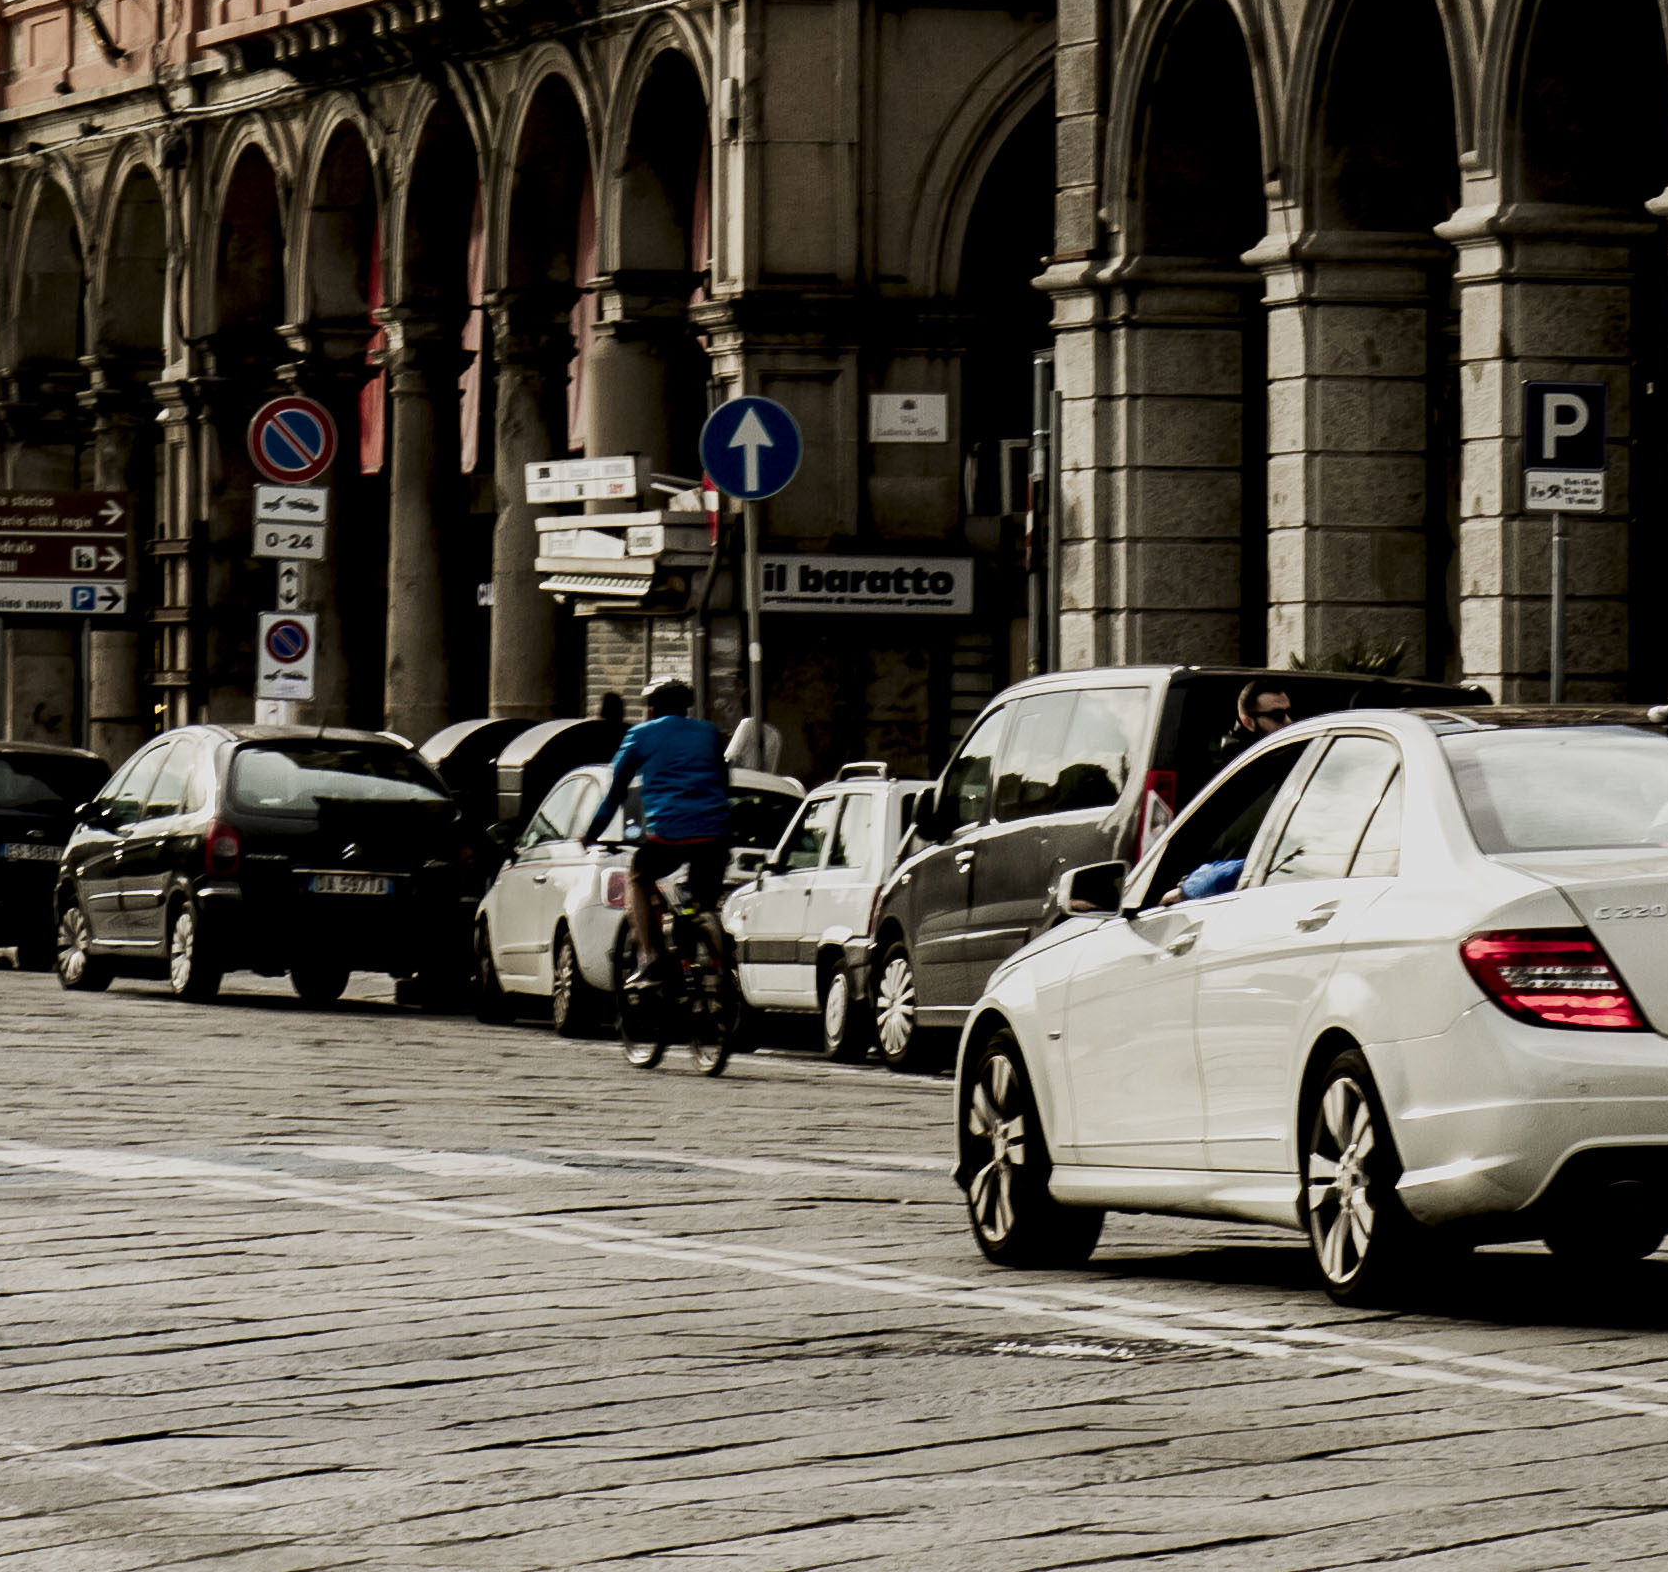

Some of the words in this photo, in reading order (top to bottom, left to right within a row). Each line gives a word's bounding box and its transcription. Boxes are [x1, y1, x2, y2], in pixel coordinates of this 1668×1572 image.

[1541, 393, 1590, 460] P
[10, 493, 55, 508] storico
[264, 530, 315, 550] 0-24
[763, 563, 787, 592] il
[799, 564, 954, 595] baratto
